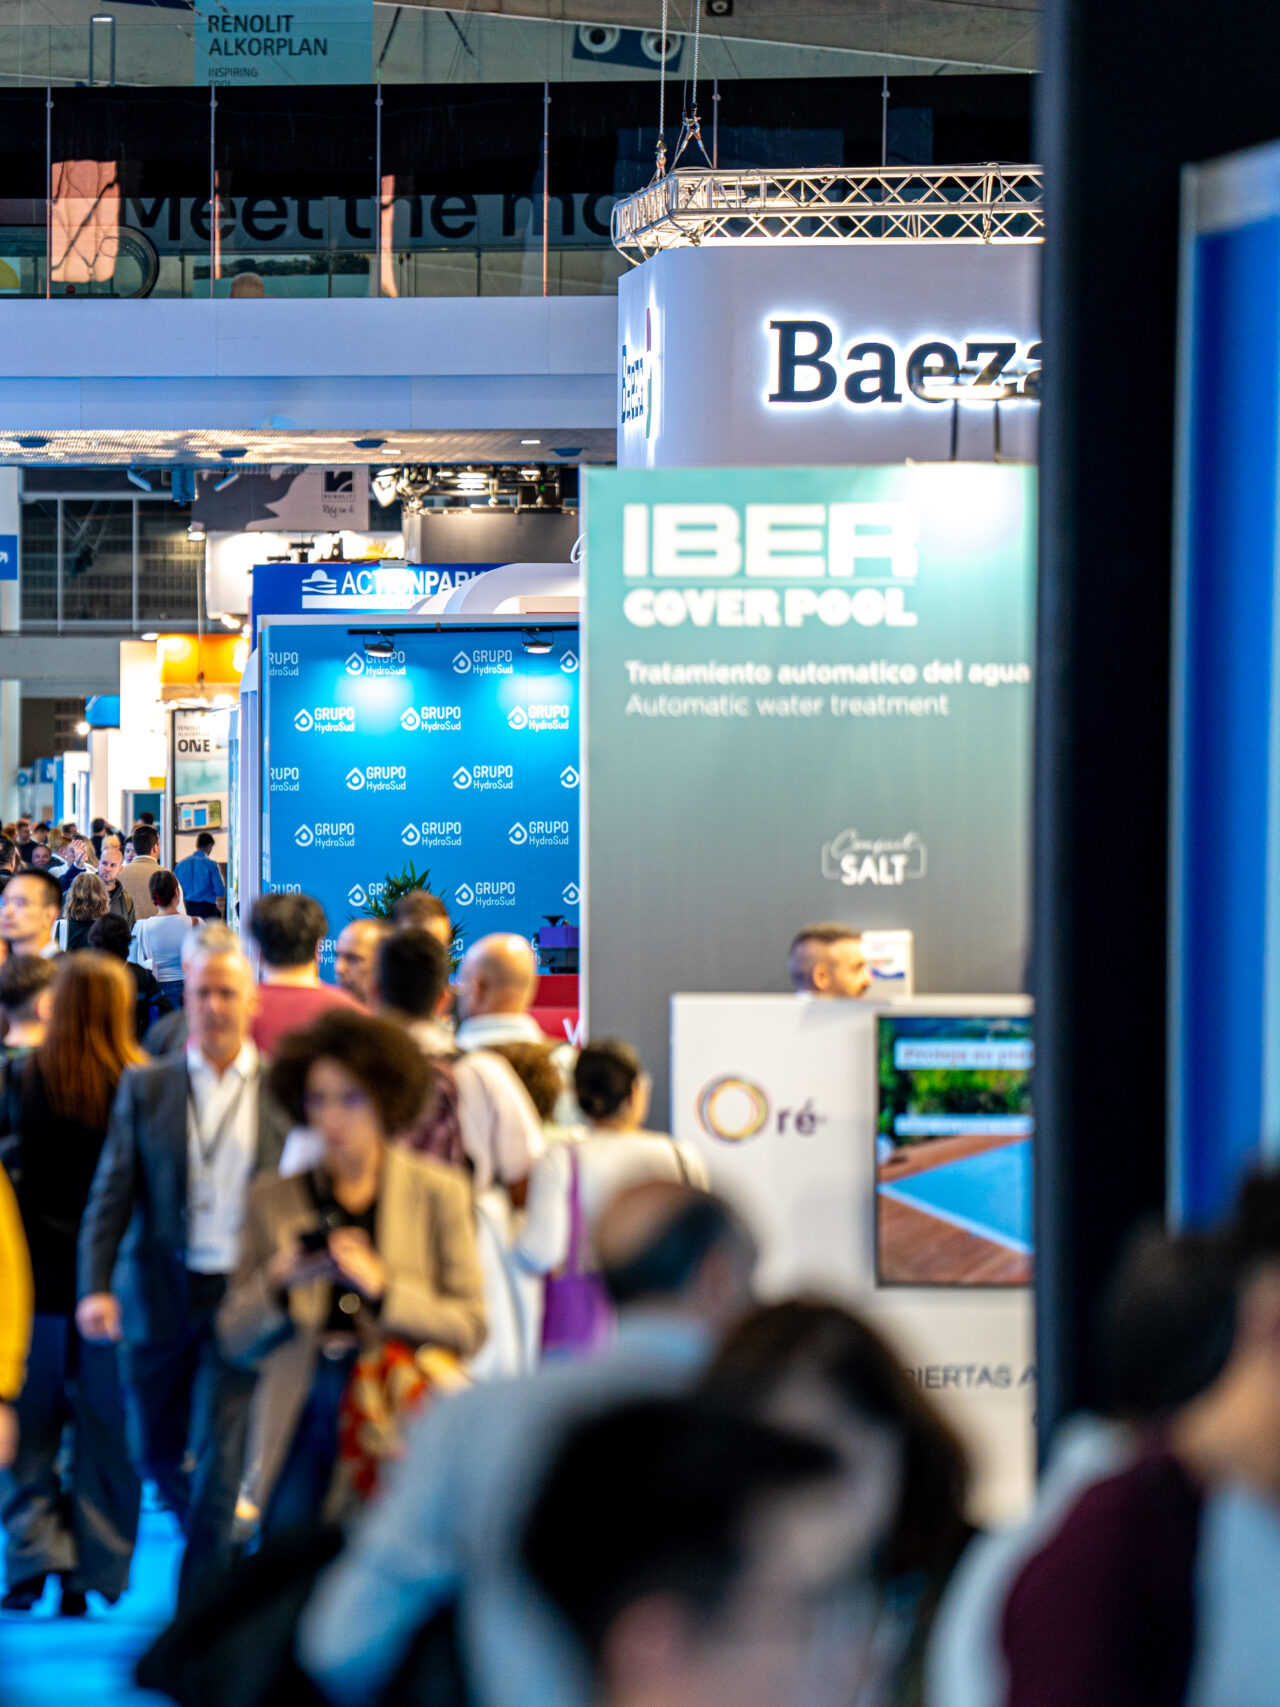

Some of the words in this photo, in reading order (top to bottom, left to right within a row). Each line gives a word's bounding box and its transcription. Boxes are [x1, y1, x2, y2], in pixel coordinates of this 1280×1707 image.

[208, 15, 293, 33] RENOLIT
[208, 38, 328, 56] ALKORPLAN
[208, 67, 258, 78] INSPIRING
[119, 196, 324, 242] Meet
[623, 503, 920, 577] IBER
[623, 588, 782, 627] COVER
[785, 588, 918, 627] POOL
[269, 652, 299, 664] RUPO
[473, 650, 512, 662] GRUPO
[270, 666, 299, 676] droSud
[366, 665, 407, 678] HydroSud
[473, 664, 513, 676] HydroSud
[625, 660, 773, 686] Tratamiento
[777, 660, 918, 686] automatico
[923, 660, 963, 685] del
[968, 663, 1032, 688] agua
[528, 705, 569, 718] GRUPO
[625, 693, 751, 717] Automatic
[756, 696, 822, 717] water
[830, 693, 951, 717] treatment
[314, 707, 355, 721] GRUPO
[421, 706, 461, 719] GRUPO
[314, 722, 355, 734] HydroSud
[421, 720, 461, 733] HydroSud
[528, 719, 569, 732] HydroSud
[178, 739, 210, 752] ONE
[270, 767, 299, 780] RUPO
[366, 766, 406, 779] GRUPO
[473, 765, 513, 778] GRUPO
[270, 781, 299, 791] droSud
[366, 780, 406, 792] HydroSud
[473, 779, 513, 791] HydroSud
[315, 823, 355, 836] GRUPO
[422, 822, 461, 835] GRUPO
[529, 821, 568, 834] GRUPO
[315, 837, 355, 849] HydroSud
[422, 836, 461, 848] HydroSud
[529, 835, 568, 847] HydroSud
[841, 853, 909, 886] SALT
[271, 884, 301, 896] RUPO
[476, 882, 515, 895] GRUPO
[476, 896, 515, 908] HydroSud
